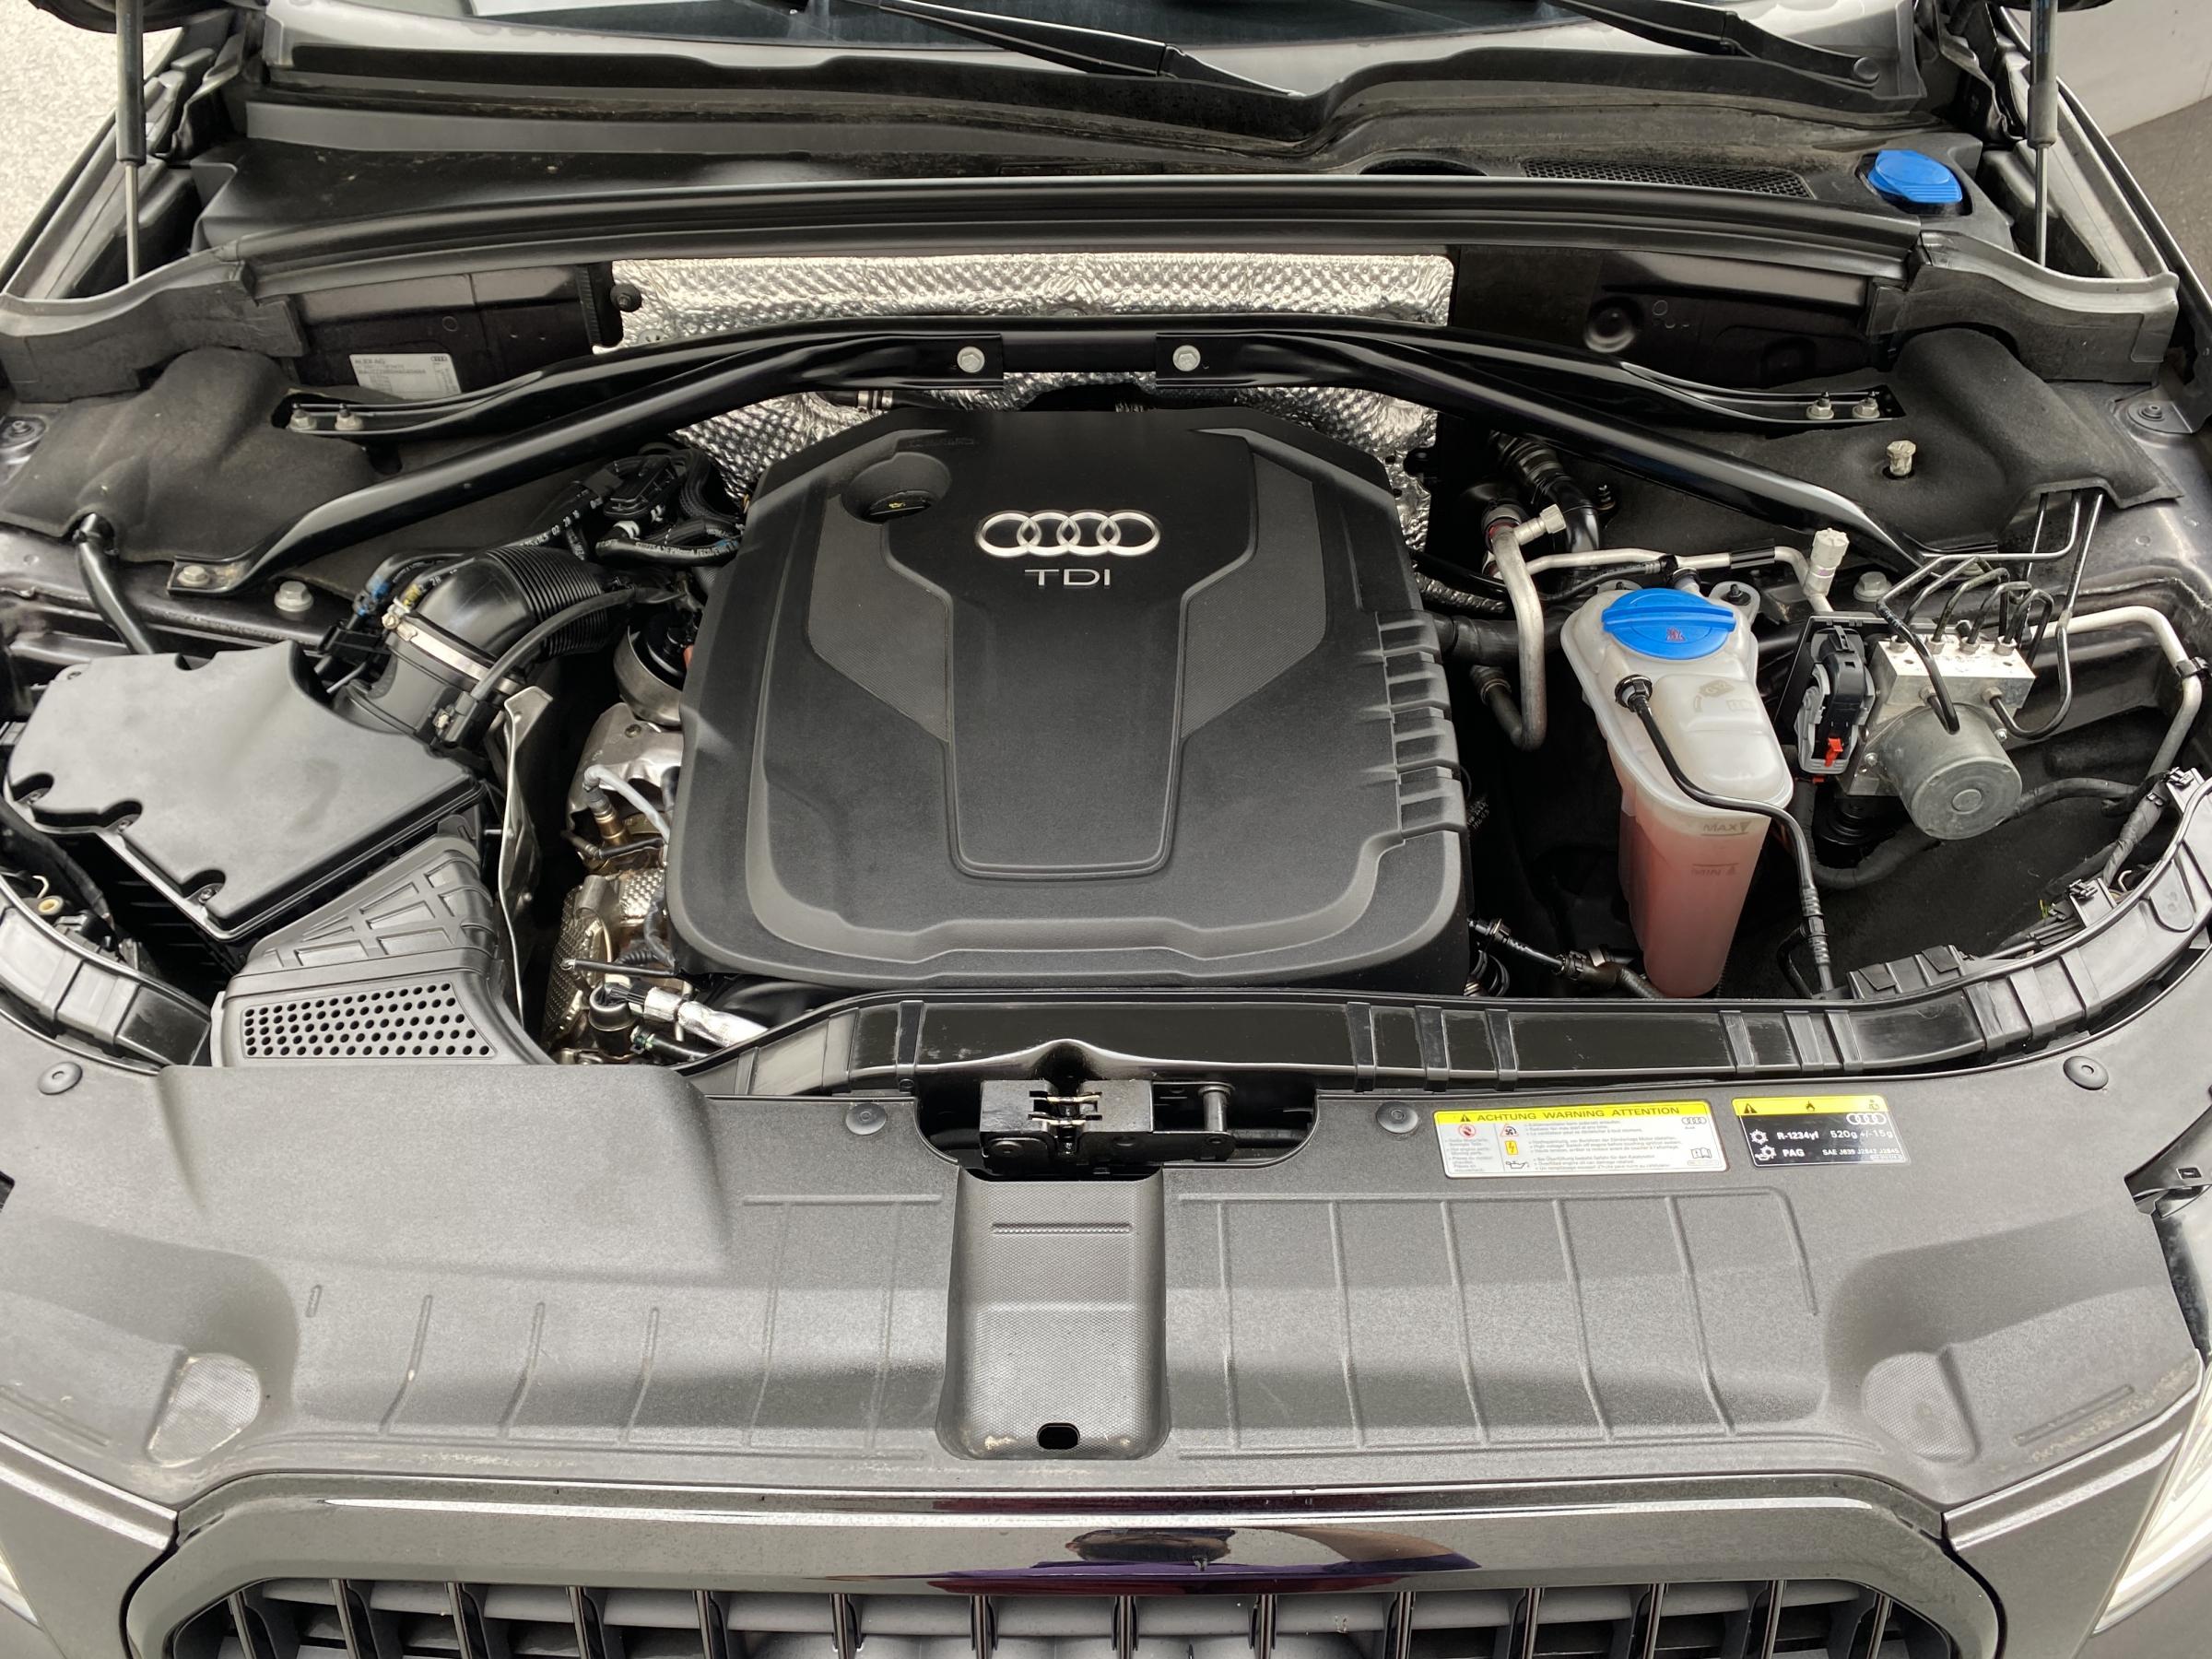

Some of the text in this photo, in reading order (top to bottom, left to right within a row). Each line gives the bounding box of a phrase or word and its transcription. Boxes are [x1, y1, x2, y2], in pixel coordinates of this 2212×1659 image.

[1024, 569, 1111, 586] TDI
[1702, 822, 1737, 832] MAX
[1691, 868, 1721, 877] MIN
[1477, 1107, 1680, 1122] ACHTUNG WARNING ATTENTION
[1830, 1130, 1858, 1139] 520g
[1782, 1148, 1806, 1158] PAG
